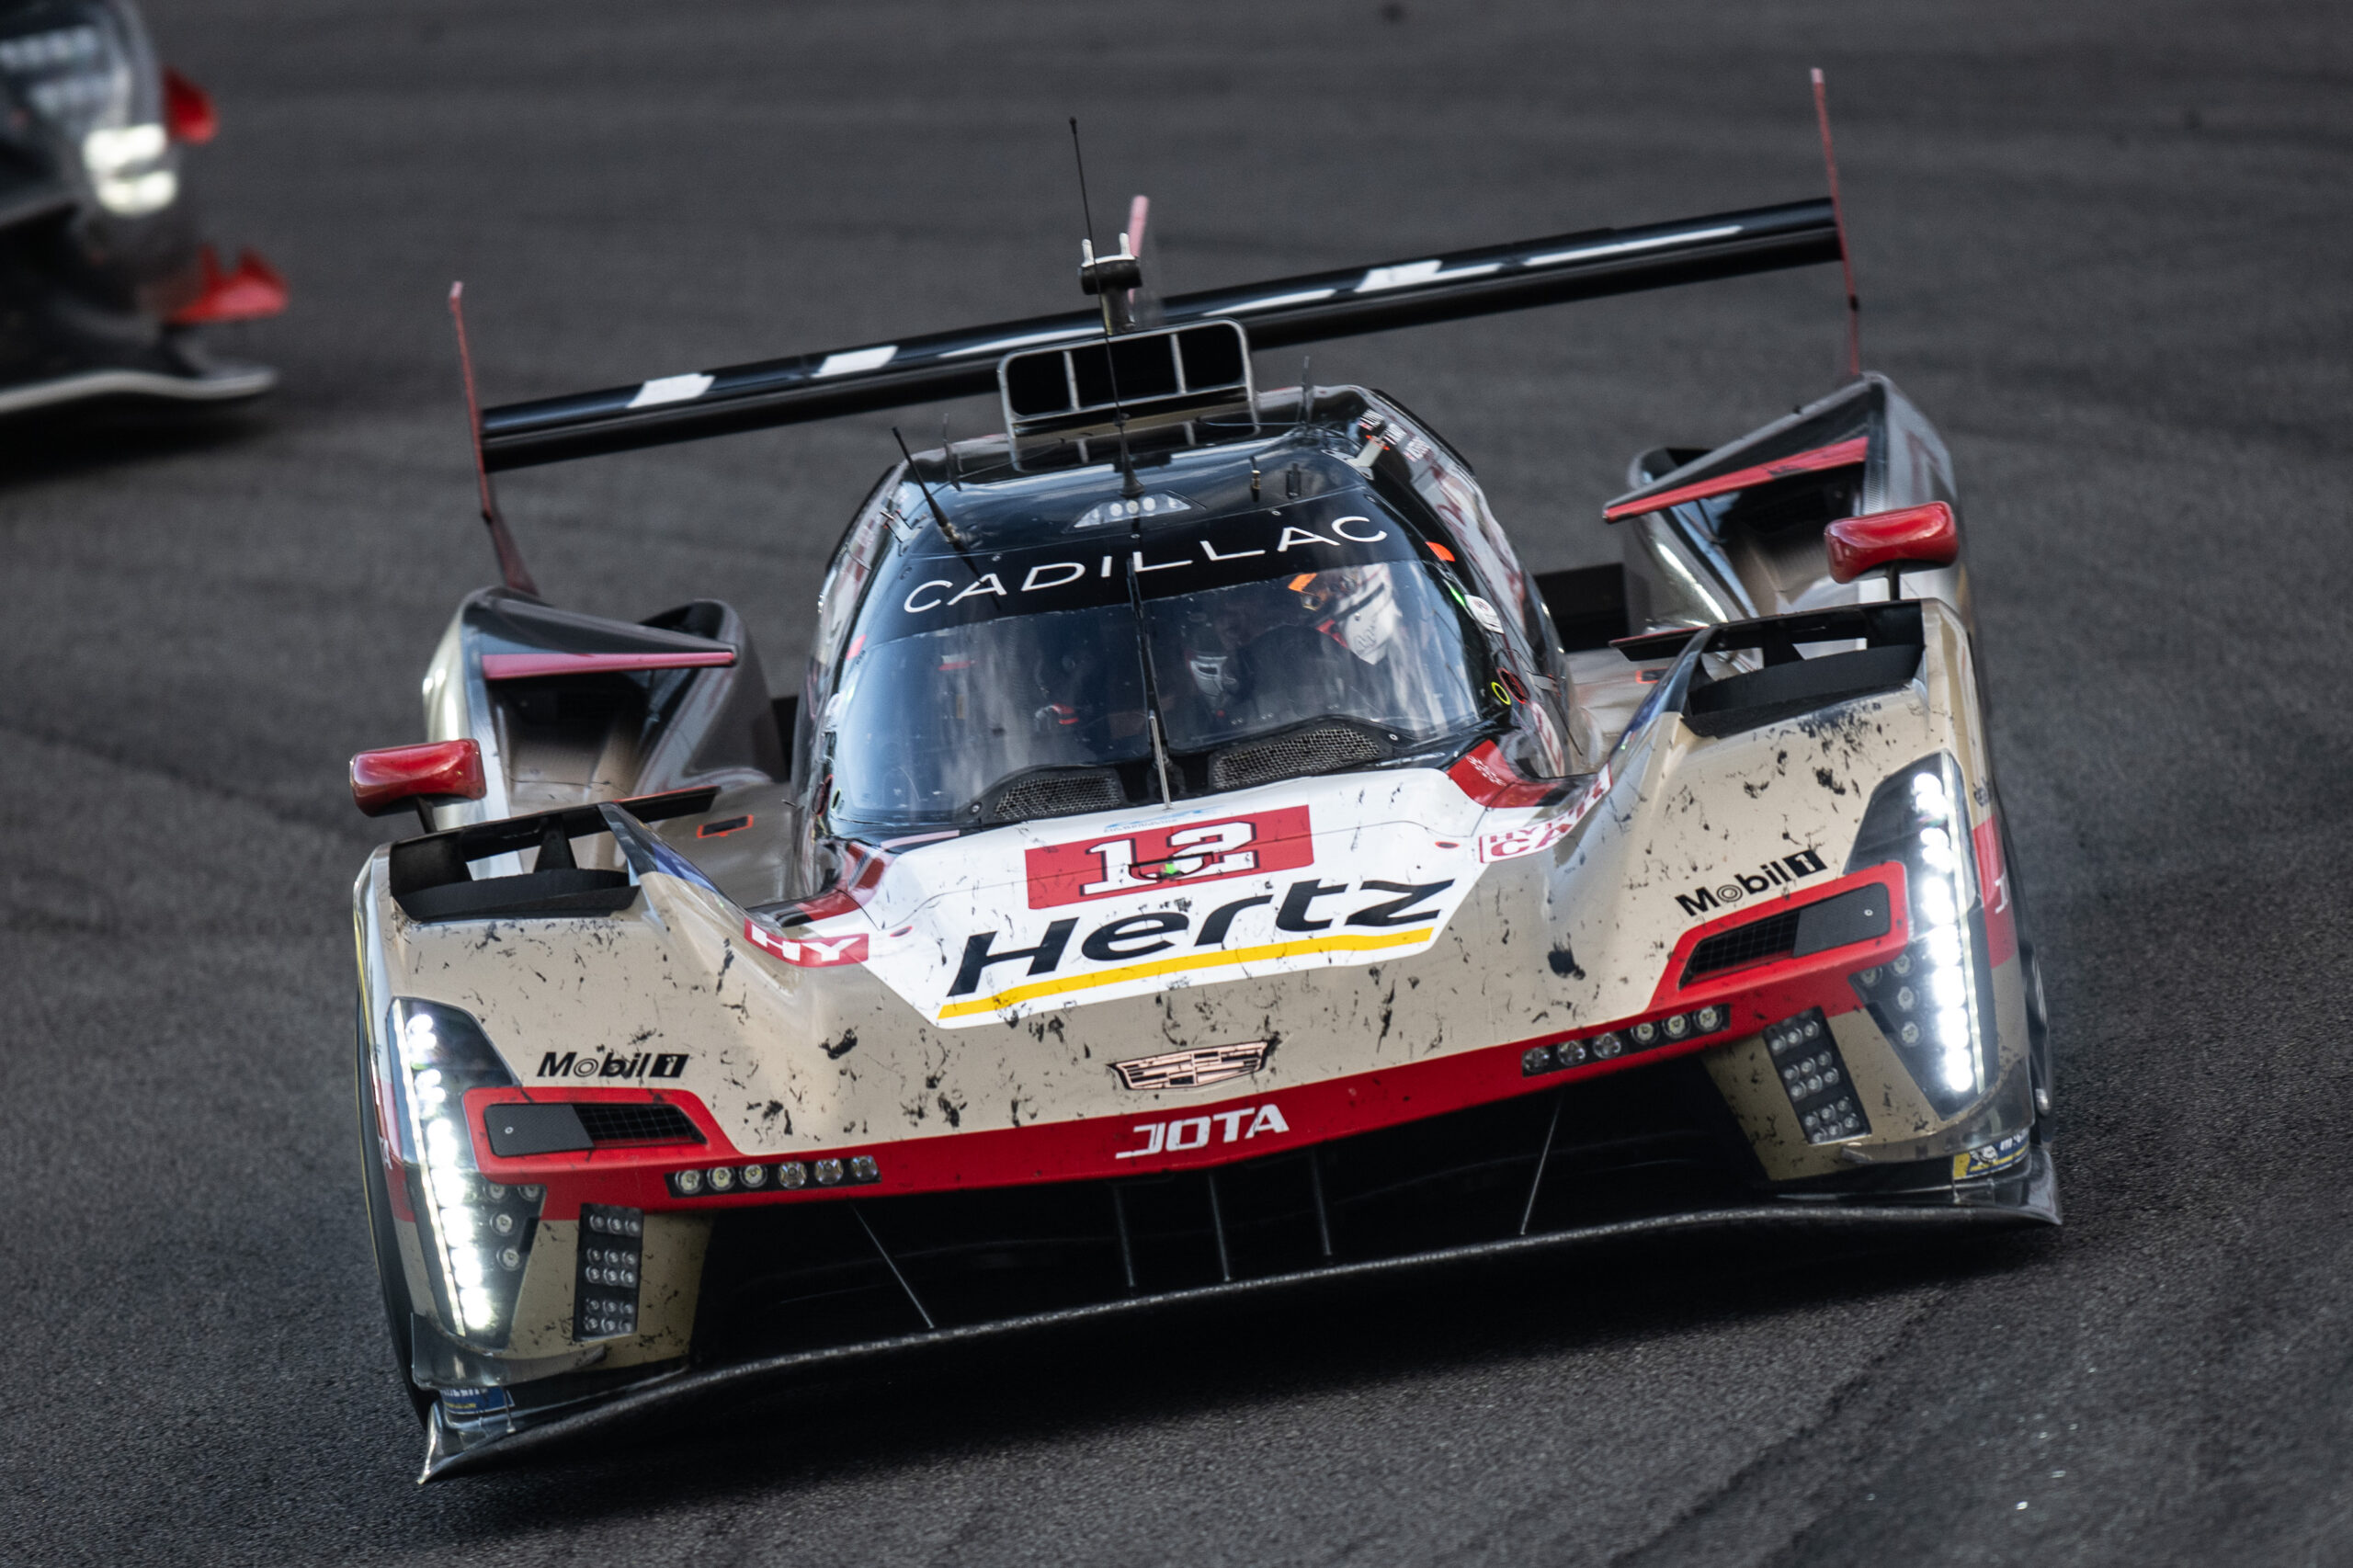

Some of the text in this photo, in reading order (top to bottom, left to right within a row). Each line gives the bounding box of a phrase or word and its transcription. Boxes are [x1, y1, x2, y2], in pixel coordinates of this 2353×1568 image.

[904, 516, 1388, 613] CADILLAC
[1081, 821, 1267, 895] 12
[1675, 860, 1792, 917] Mobil
[751, 923, 861, 962] HY
[947, 879, 1454, 997] Hertz
[537, 1051, 652, 1079] Mobil
[1115, 1104, 1290, 1159] JOTA
